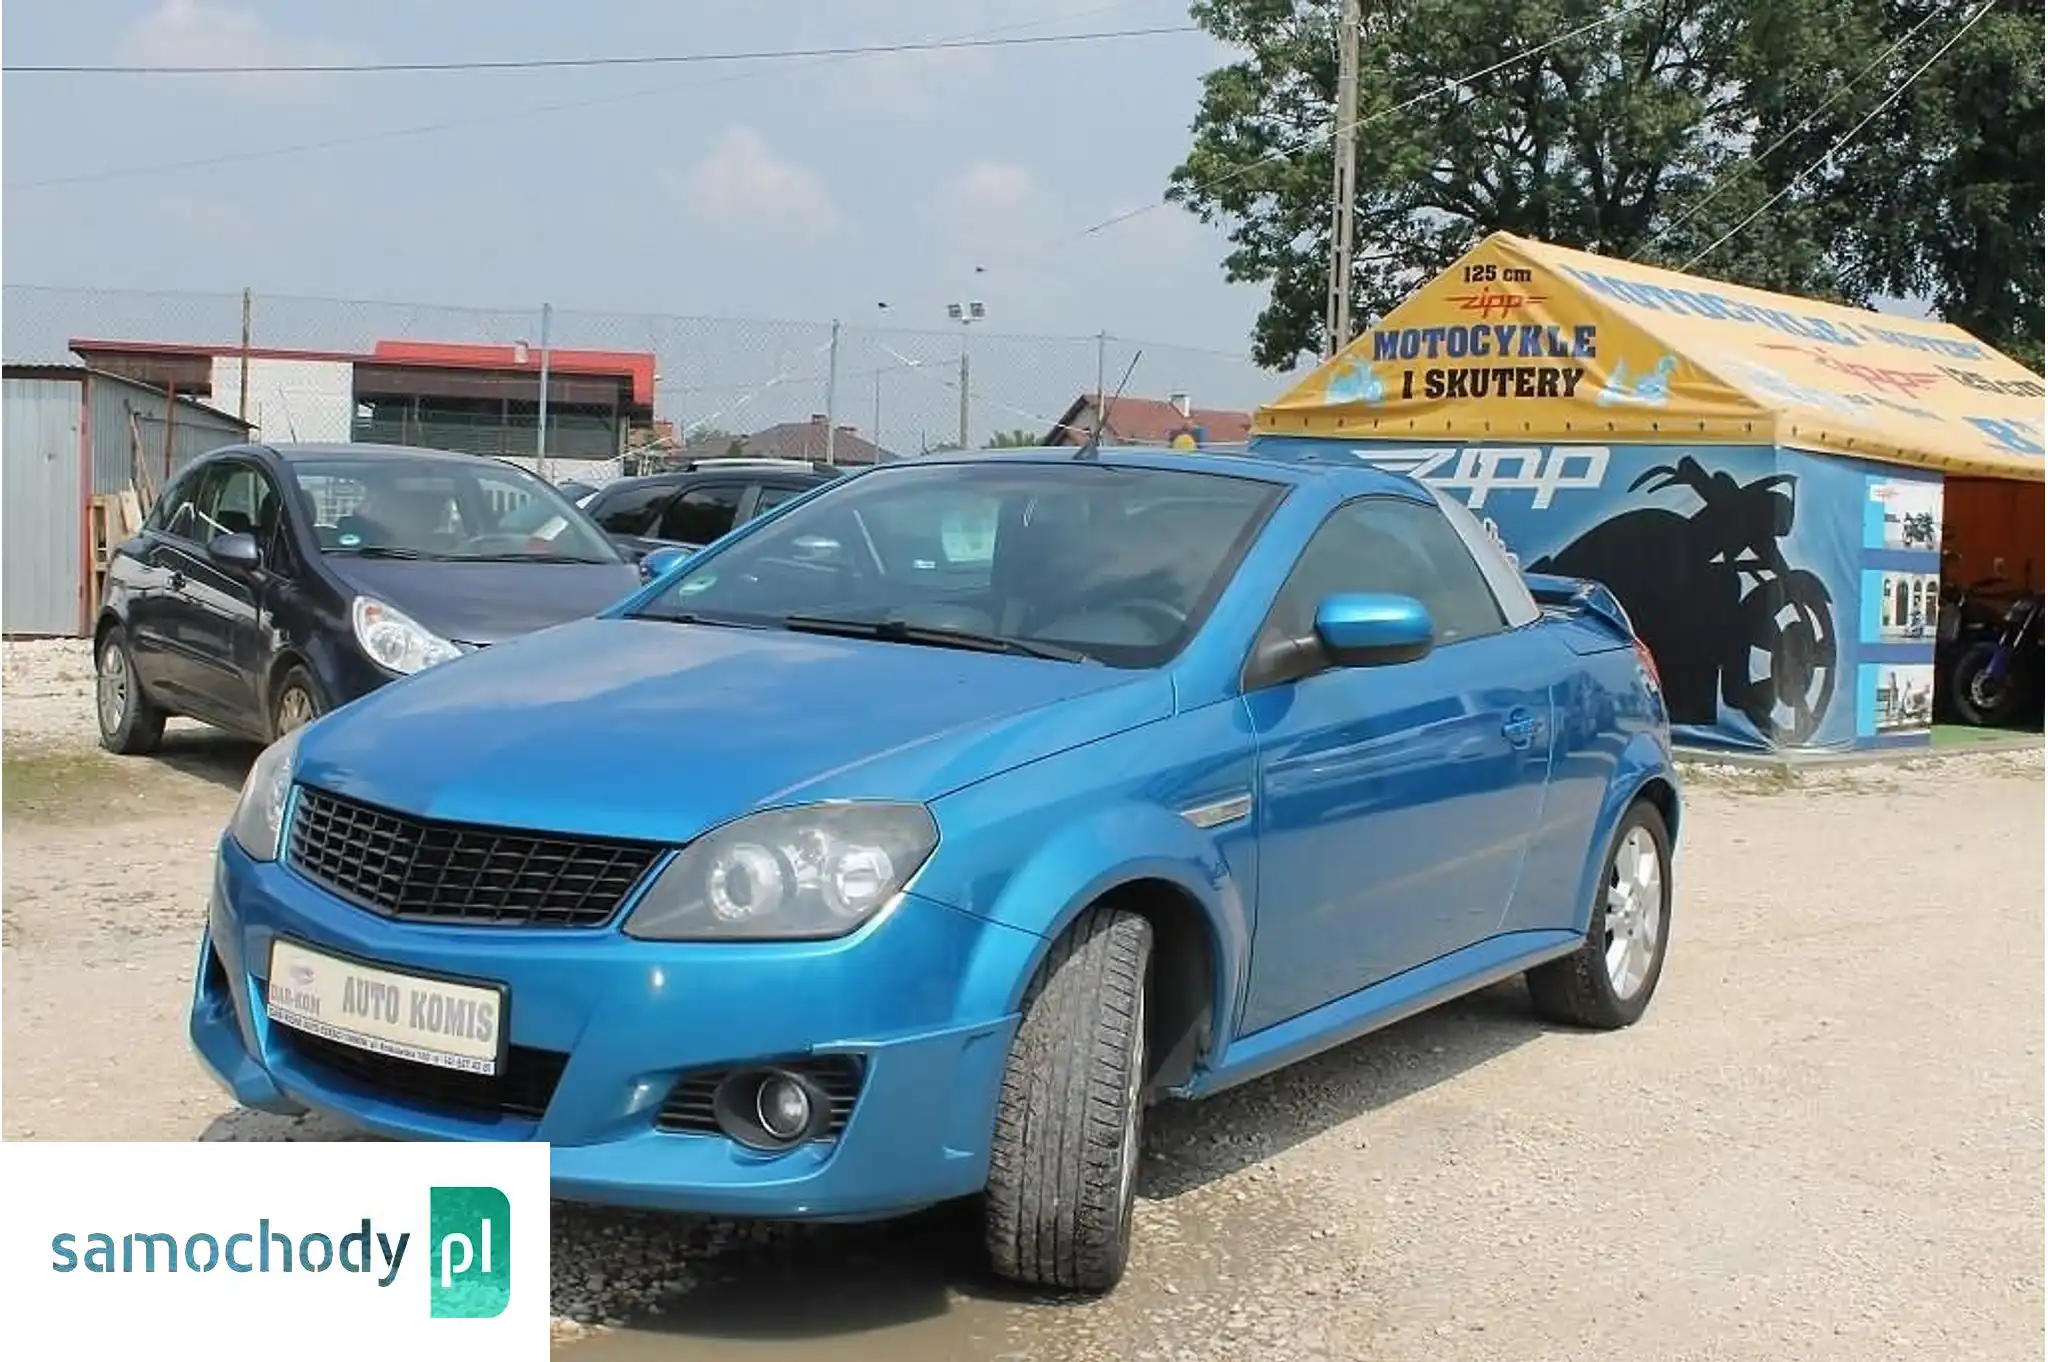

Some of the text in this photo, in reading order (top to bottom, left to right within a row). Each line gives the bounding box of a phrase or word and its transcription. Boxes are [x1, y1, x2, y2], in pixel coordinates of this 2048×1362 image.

[1464, 264, 1532, 283] 125 cm
[1373, 324, 1596, 360] MOTOCYKLE
[1402, 367, 1584, 399] I SKUTERY
[342, 976, 400, 1026] AUTO
[408, 990, 494, 1043] KOMIS
